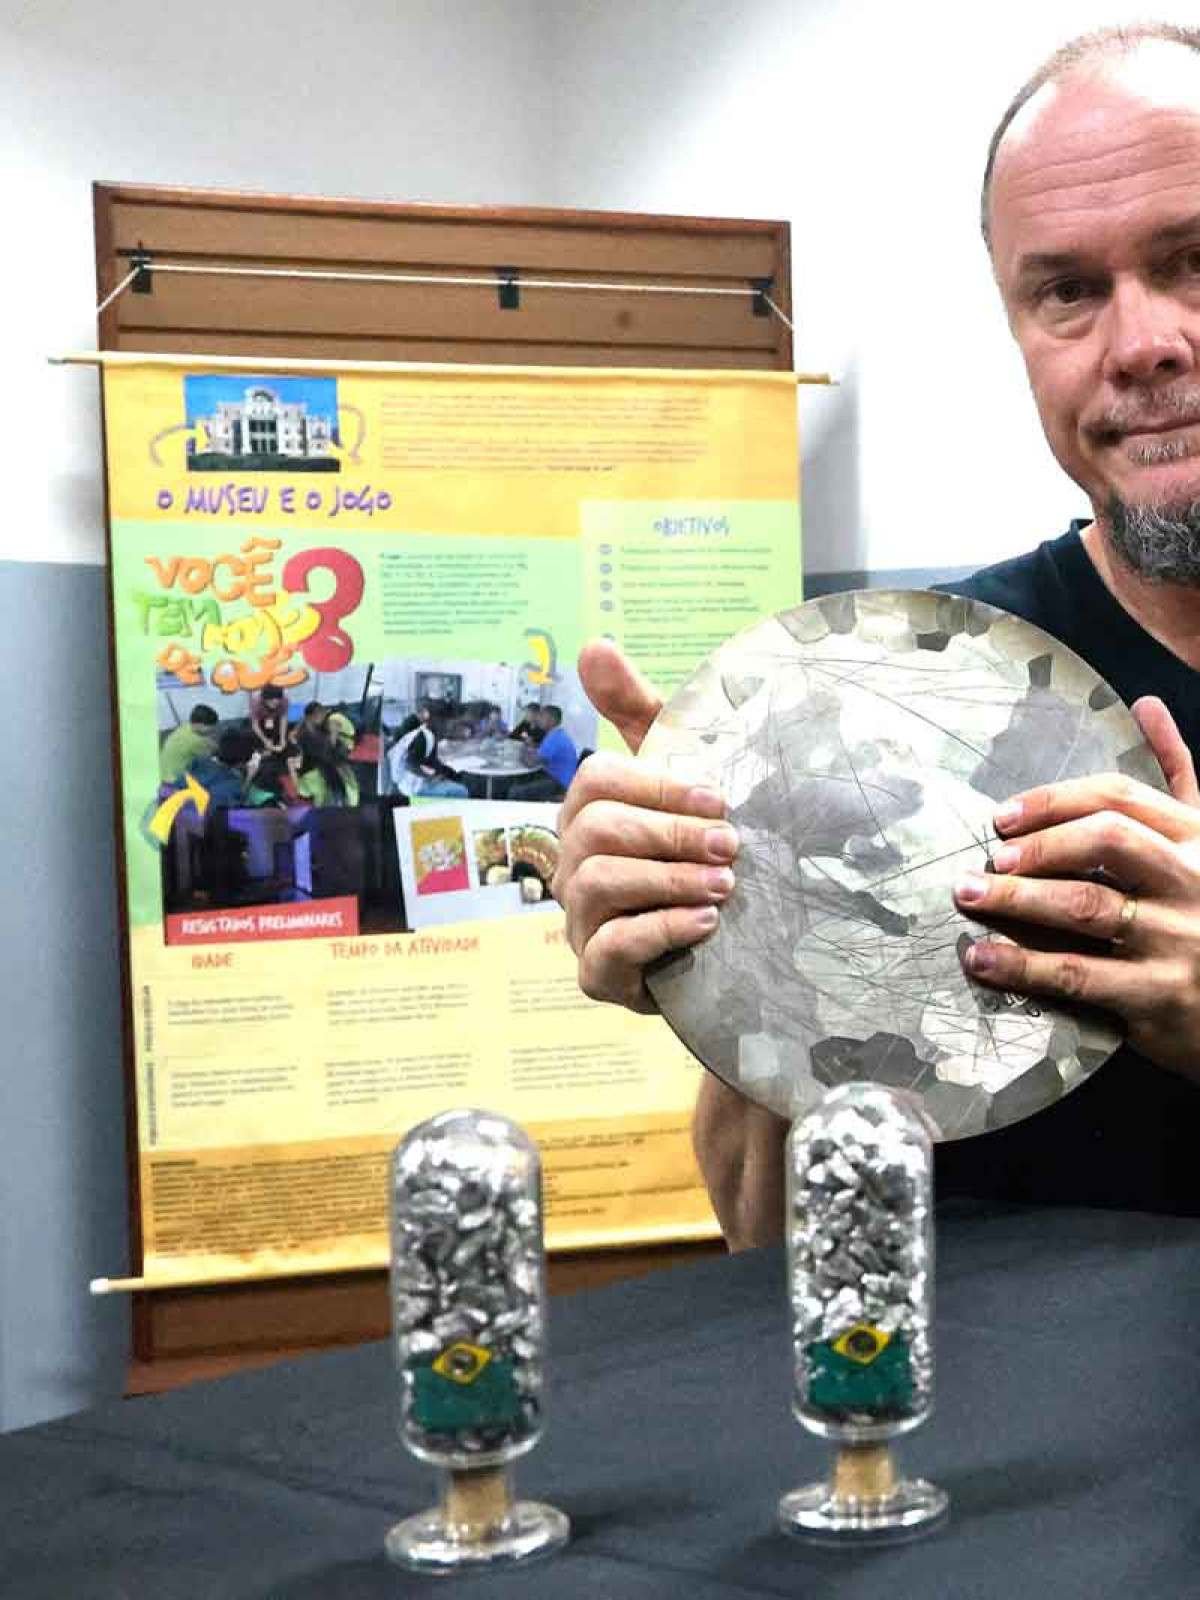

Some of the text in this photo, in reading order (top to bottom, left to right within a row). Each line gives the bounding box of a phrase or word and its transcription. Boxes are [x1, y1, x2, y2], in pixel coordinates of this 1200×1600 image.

[156, 484, 392, 516] O MUSEU E O JOGO
[132, 591, 222, 638] TEM
[191, 951, 234, 970] IDADE
[328, 941, 379, 960] TEMPO
[384, 940, 403, 955] DA
